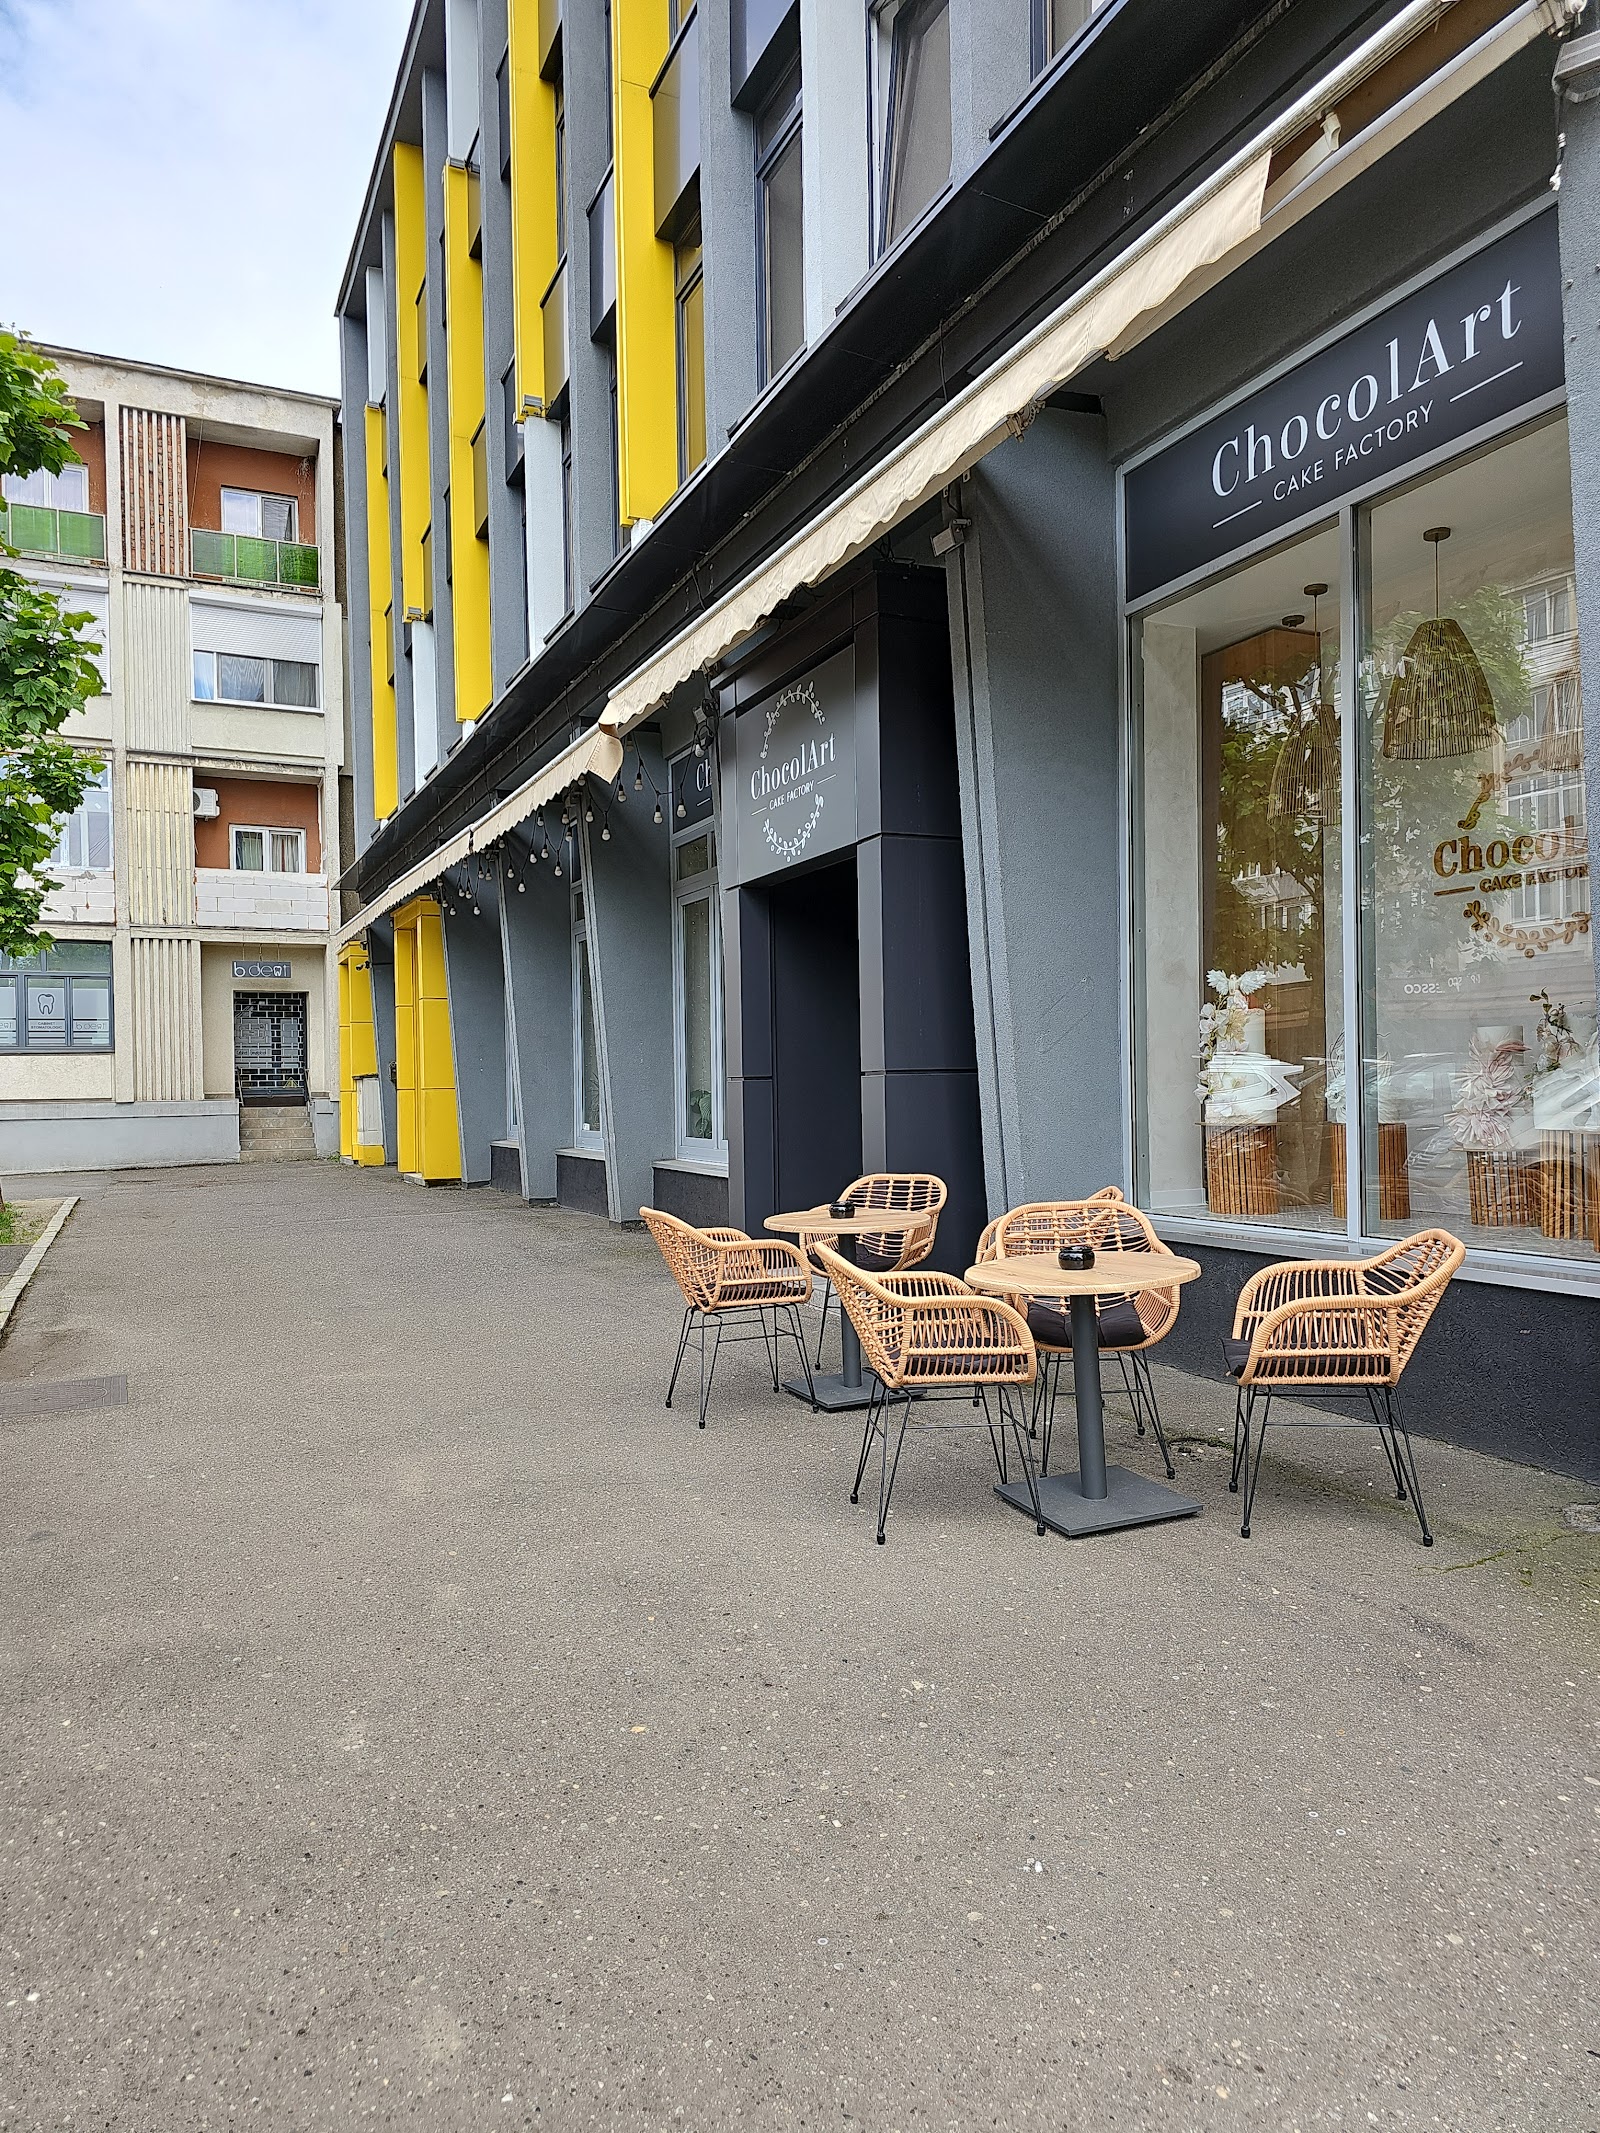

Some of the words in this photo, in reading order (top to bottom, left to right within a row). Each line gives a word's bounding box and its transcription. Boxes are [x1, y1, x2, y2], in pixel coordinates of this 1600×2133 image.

[1211, 279, 1523, 498] ChocolArt
[1272, 459, 1324, 501] CAKE
[1334, 399, 1435, 471] FACTORY
[696, 758, 712, 792] Ch
[749, 732, 837, 800] ChocolArt
[769, 796, 785, 811] CAKE
[786, 780, 815, 804] FACTORY
[1433, 815, 1588, 878] Chocol
[1479, 873, 1523, 893] CAKE
[1526, 862, 1588, 886] FACTOR
